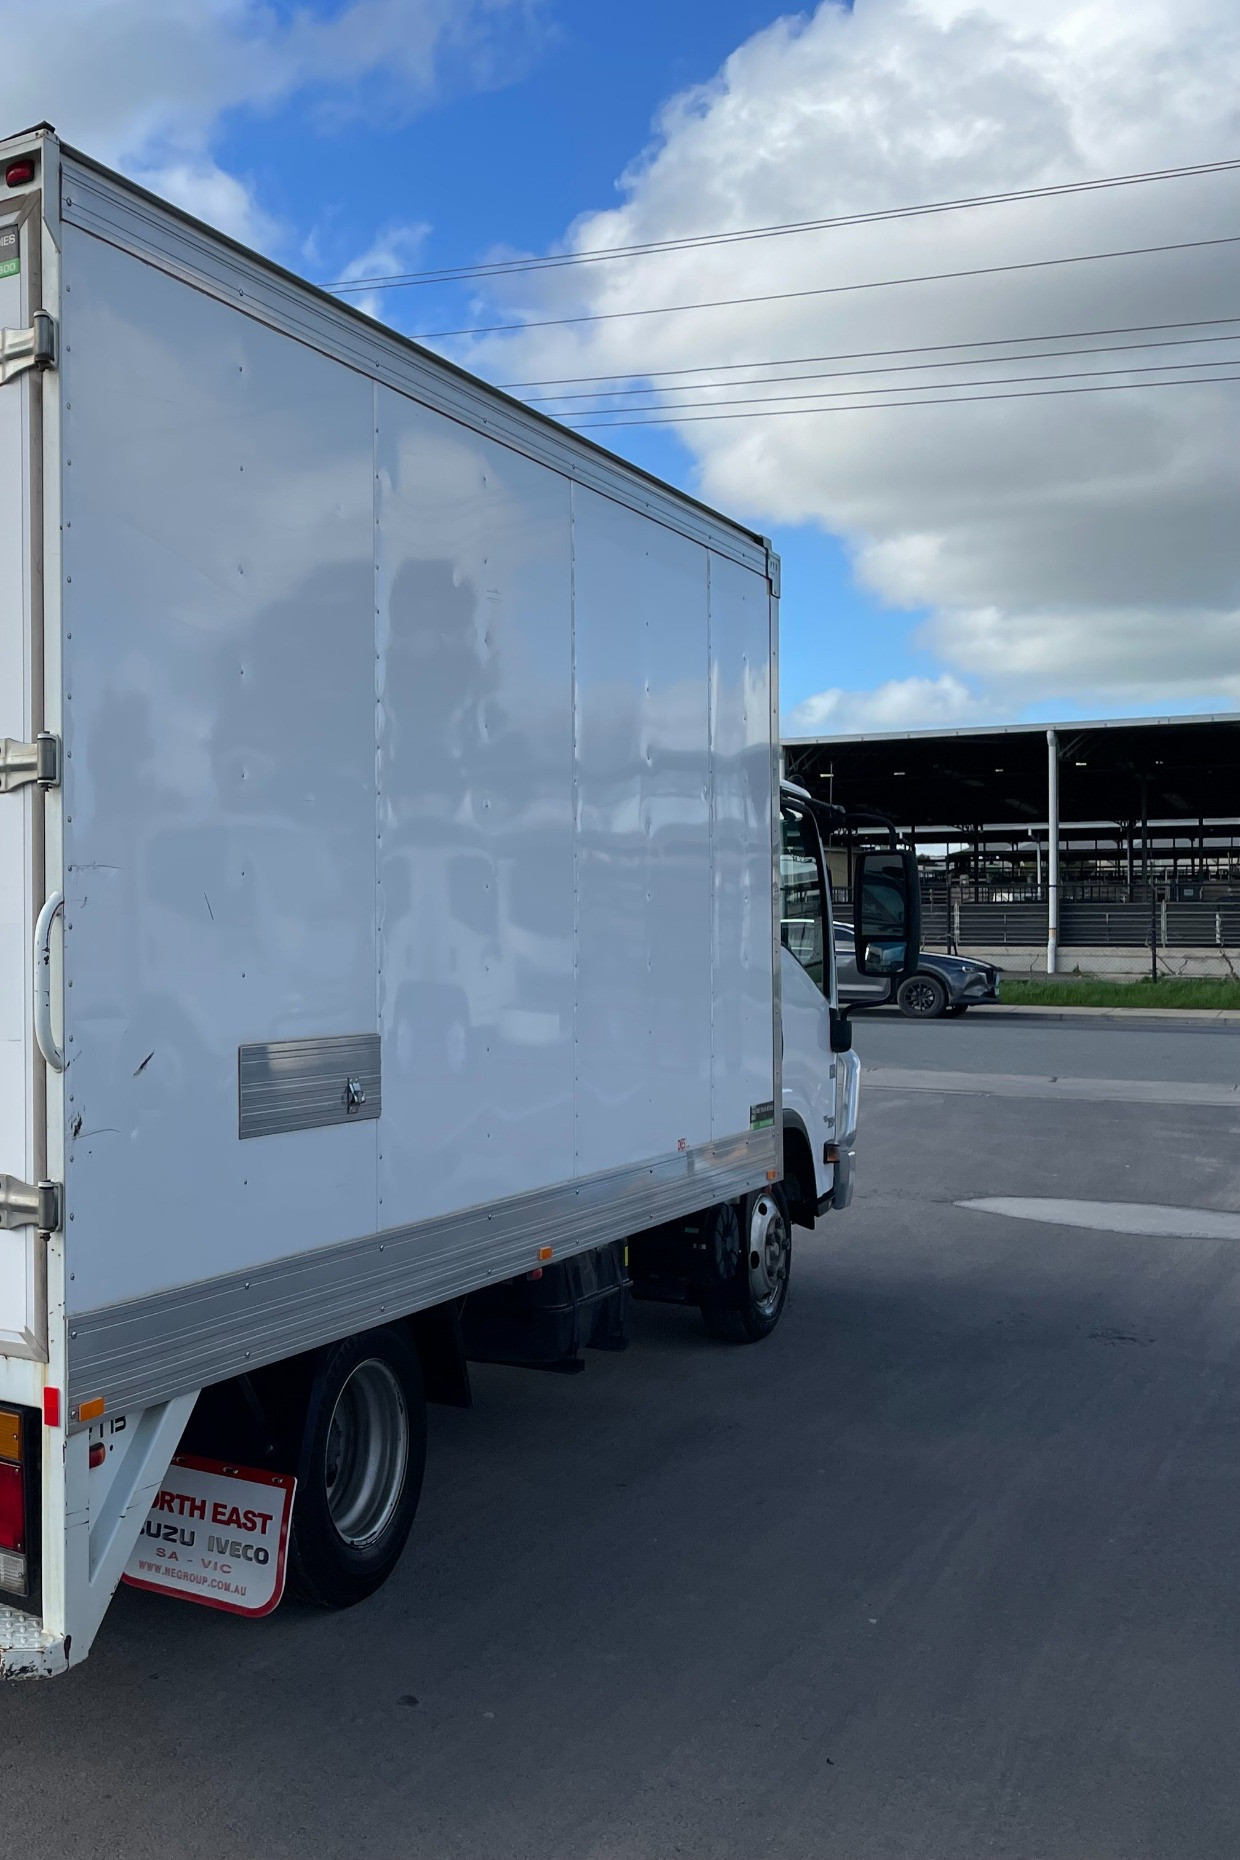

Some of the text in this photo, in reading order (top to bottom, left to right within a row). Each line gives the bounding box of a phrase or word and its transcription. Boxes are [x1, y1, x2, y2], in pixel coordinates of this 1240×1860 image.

[151, 1491, 273, 1535] RTH EAST
[140, 1520, 270, 1565] UZU IVECO
[155, 1547, 179, 1561] SA
[200, 1558, 232, 1574] VIC
[138, 1559, 247, 1596] WWW.NEGROUP.COM.AU
